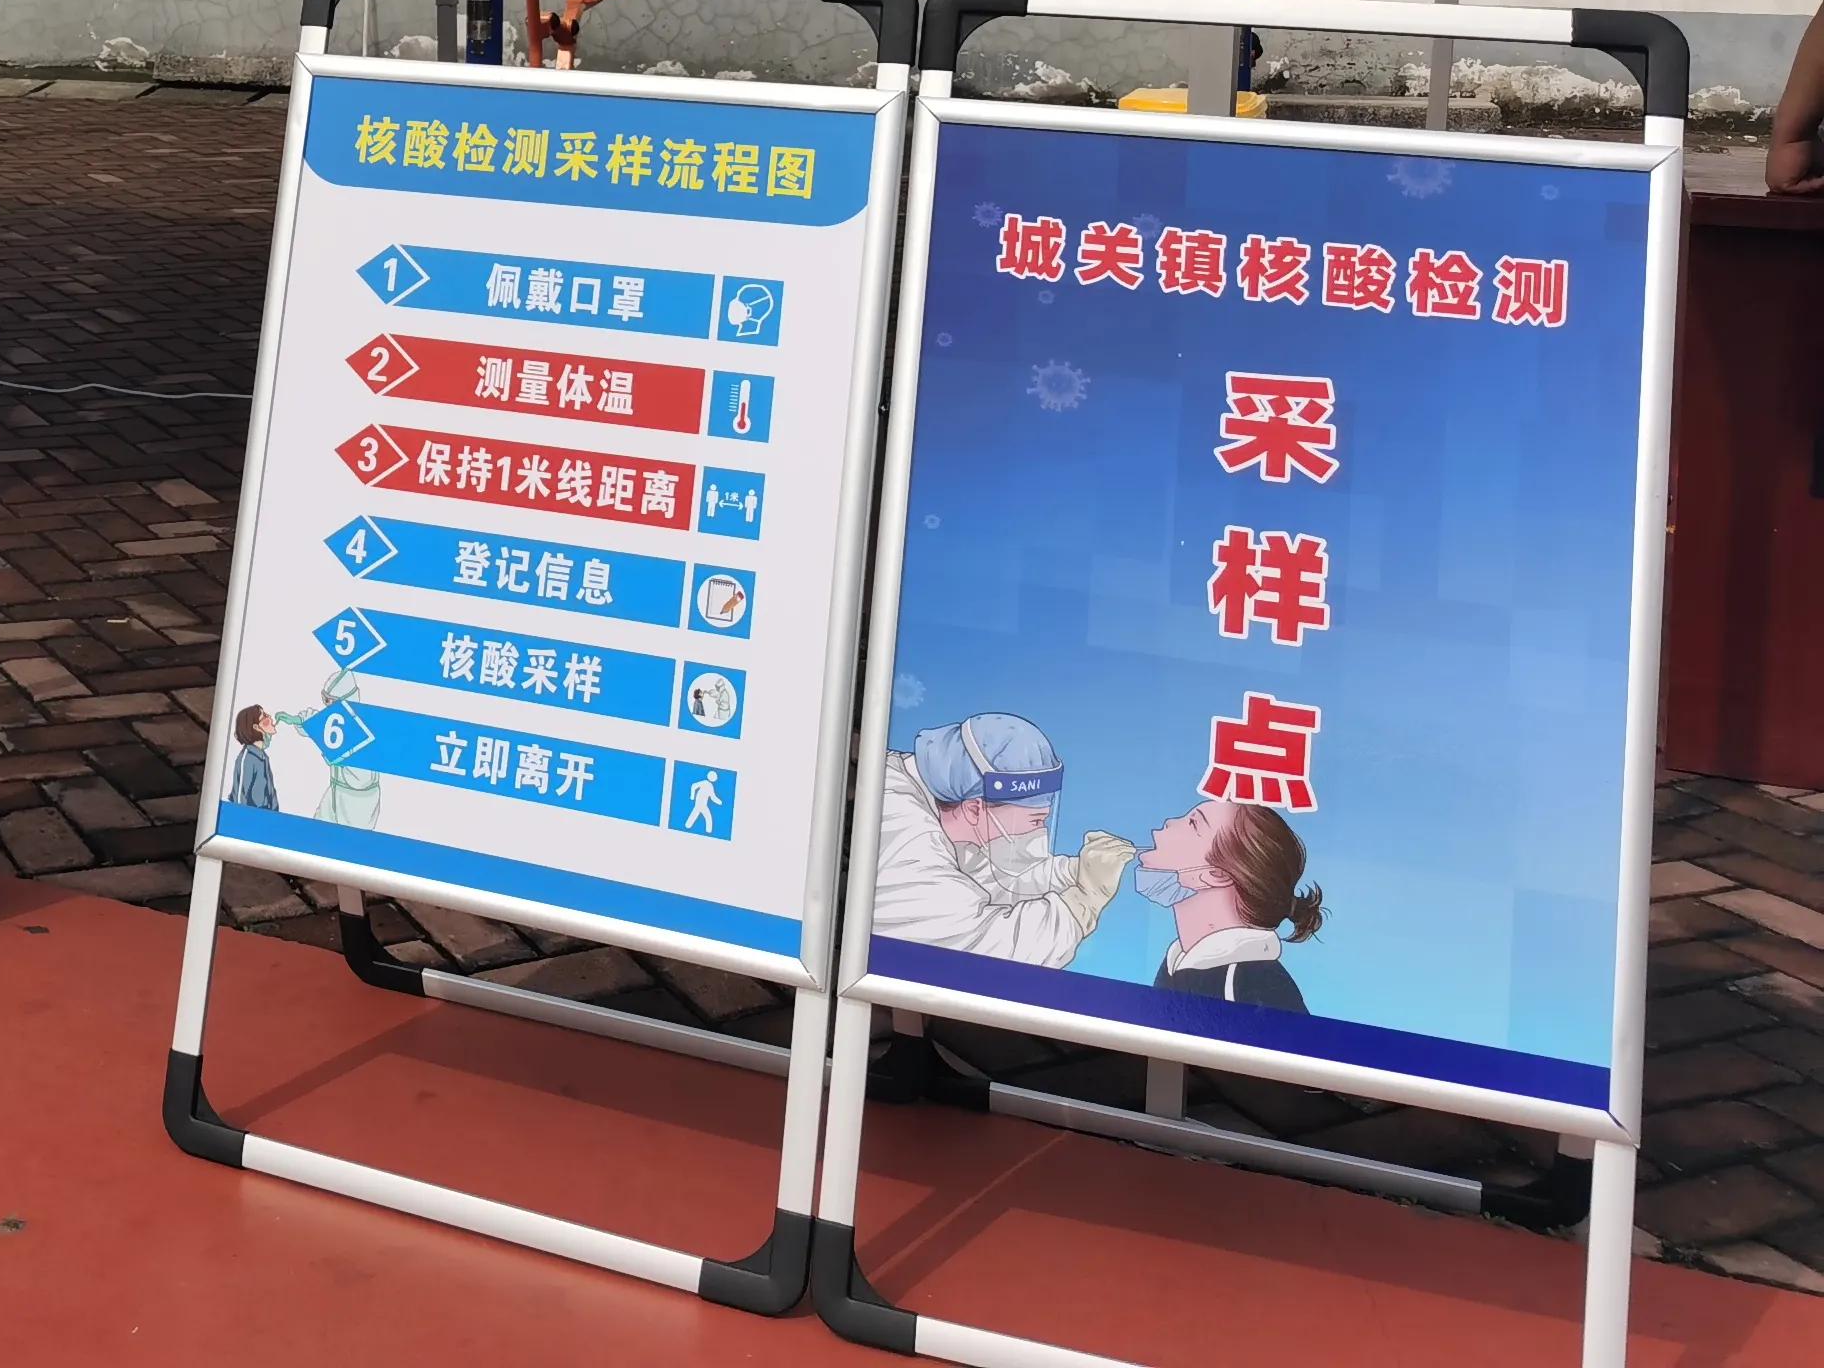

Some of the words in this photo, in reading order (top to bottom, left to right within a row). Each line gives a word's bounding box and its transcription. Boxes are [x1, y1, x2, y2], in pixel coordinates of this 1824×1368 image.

[355, 114, 817, 200] 核酸检测采样流程图
[381, 257, 398, 289] 1
[486, 262, 645, 323] 佩戴口罩
[996, 212, 1570, 327] 城关镇核酸检测
[366, 349, 390, 382] 2
[475, 355, 636, 417] 测量体温
[357, 438, 379, 473] 3
[417, 438, 679, 519] 保持1米线距离
[344, 529, 368, 563] 4
[453, 539, 615, 607] 登记信息
[1196, 369, 1340, 814] 采样点
[334, 621, 356, 656] 5
[439, 632, 604, 704] 核酸采样
[323, 712, 345, 748] 6
[431, 730, 596, 802] 立即离开
[1010, 779, 1041, 793] SANI
